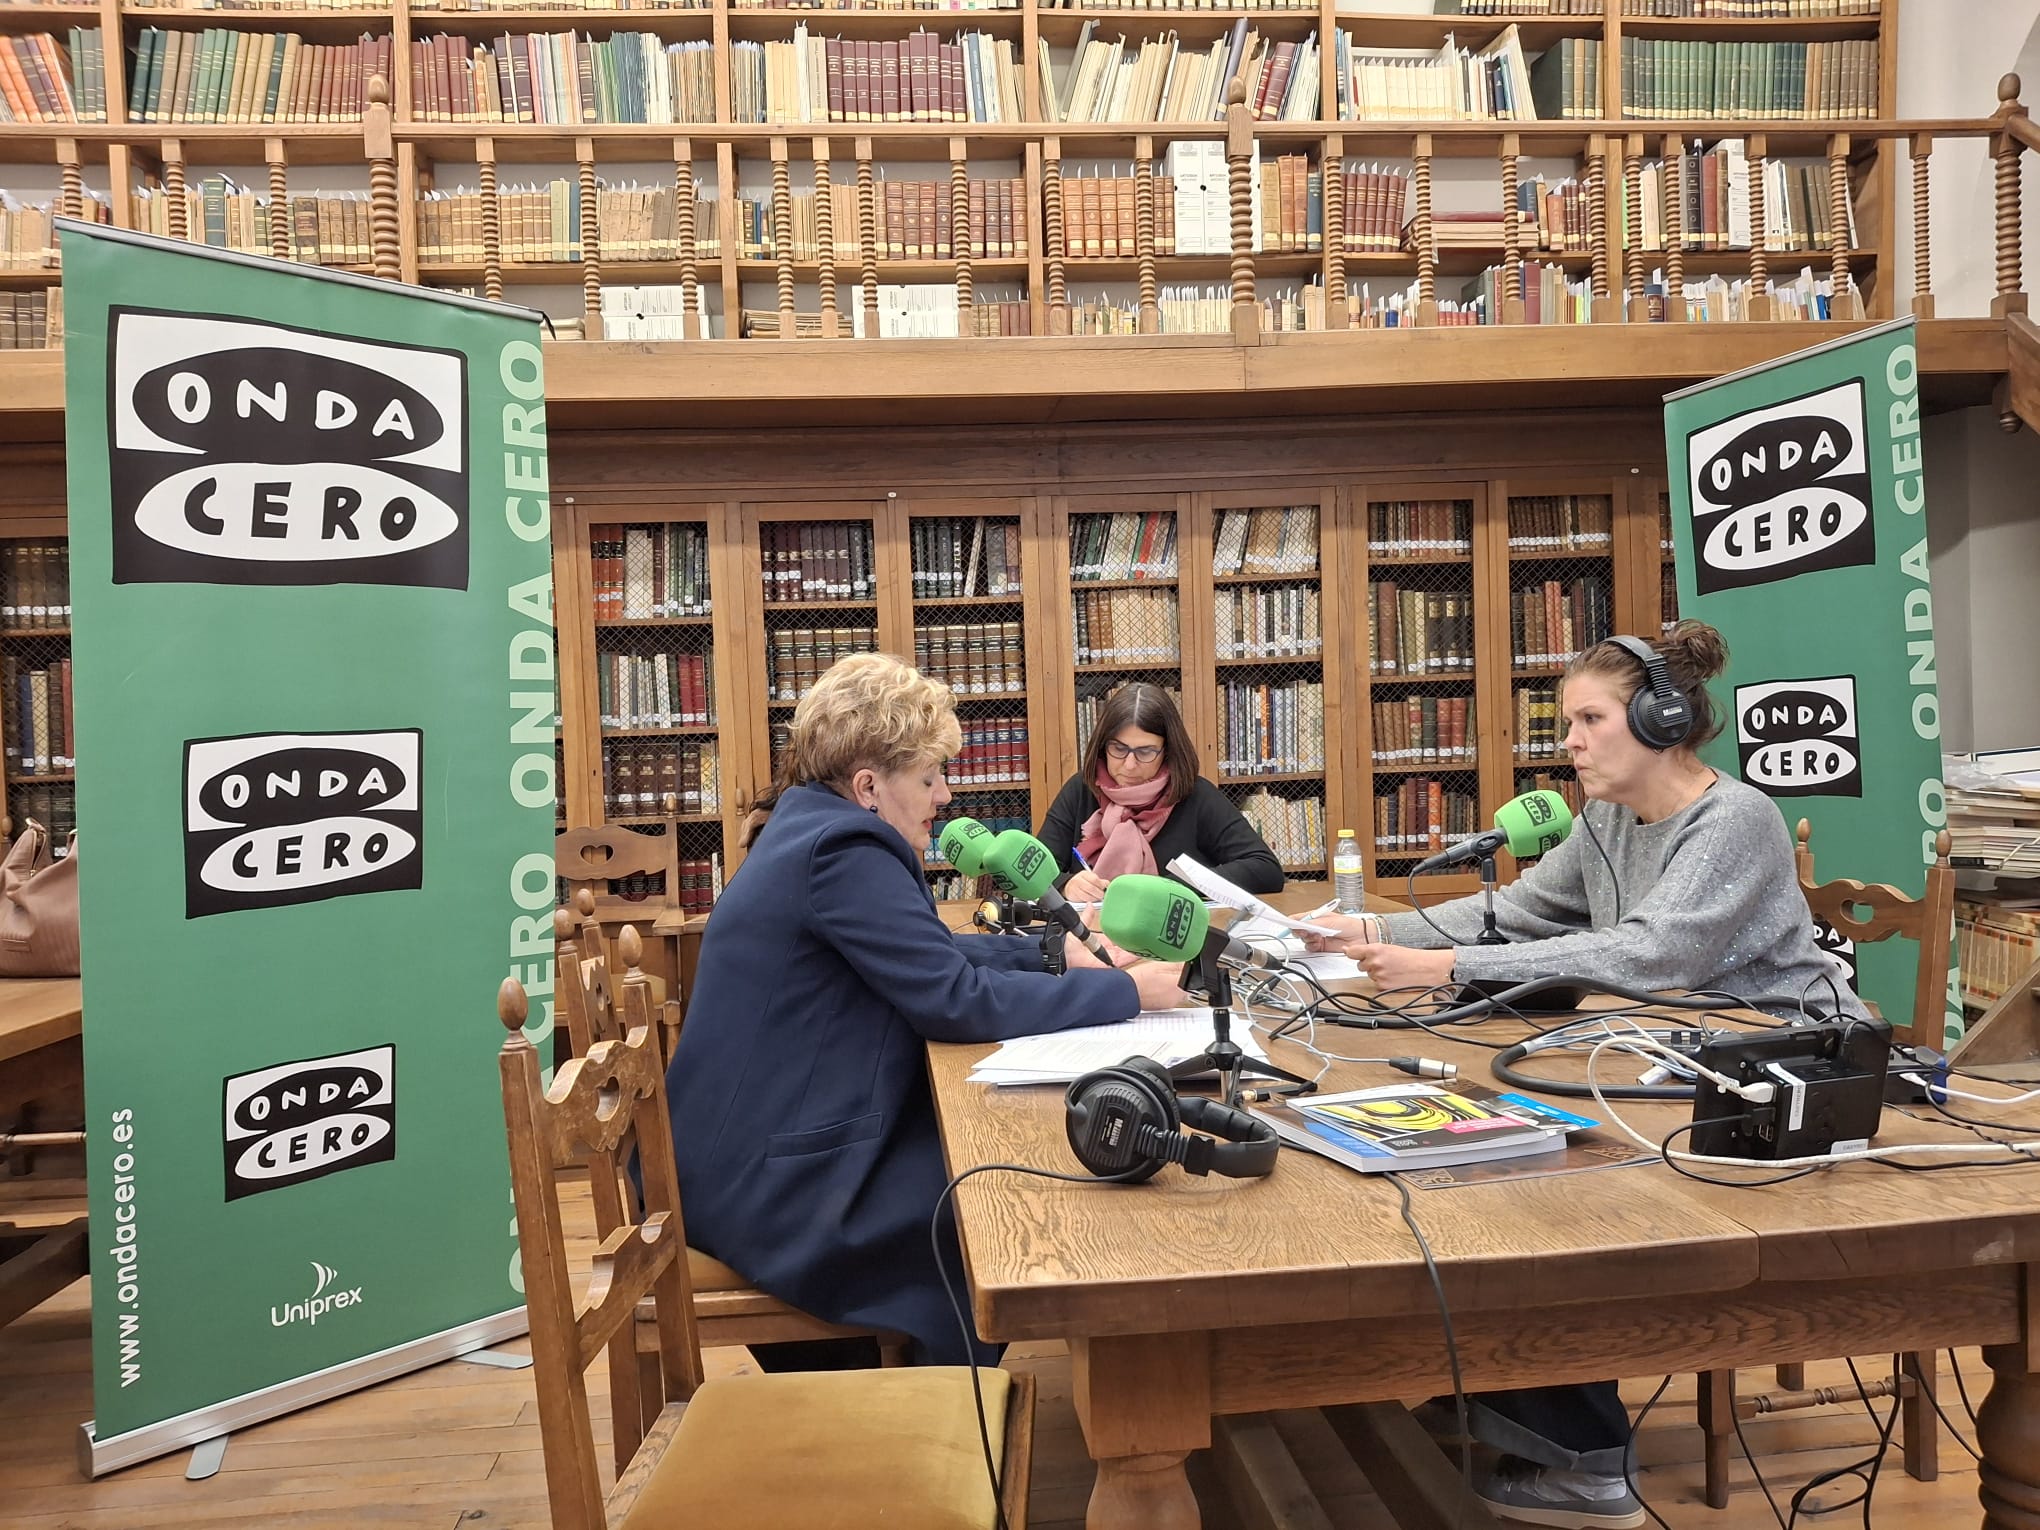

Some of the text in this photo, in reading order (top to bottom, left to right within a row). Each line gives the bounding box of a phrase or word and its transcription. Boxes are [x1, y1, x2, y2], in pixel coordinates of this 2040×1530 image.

[168, 372, 414, 441] ONDA
[500, 340, 551, 542] CERO
[1712, 431, 1837, 490] ONDA
[185, 478, 416, 541] CERO
[1724, 502, 1842, 557] CERO
[1887, 344, 1940, 740] ONDA CERO
[508, 572, 555, 808] ONDA
[1752, 705, 1837, 729] ONDA
[1759, 750, 1840, 777] CERO
[222, 768, 388, 808] ONDA
[232, 833, 389, 878] CERO
[1167, 903, 1181, 938] ONDA
[1178, 906, 1191, 940] CERO
[250, 1076, 370, 1120] ONDA
[257, 1124, 370, 1168] CERO
[110, 1108, 141, 1387] www.ondacero.es
[271, 1286, 363, 1327] Uniprex
